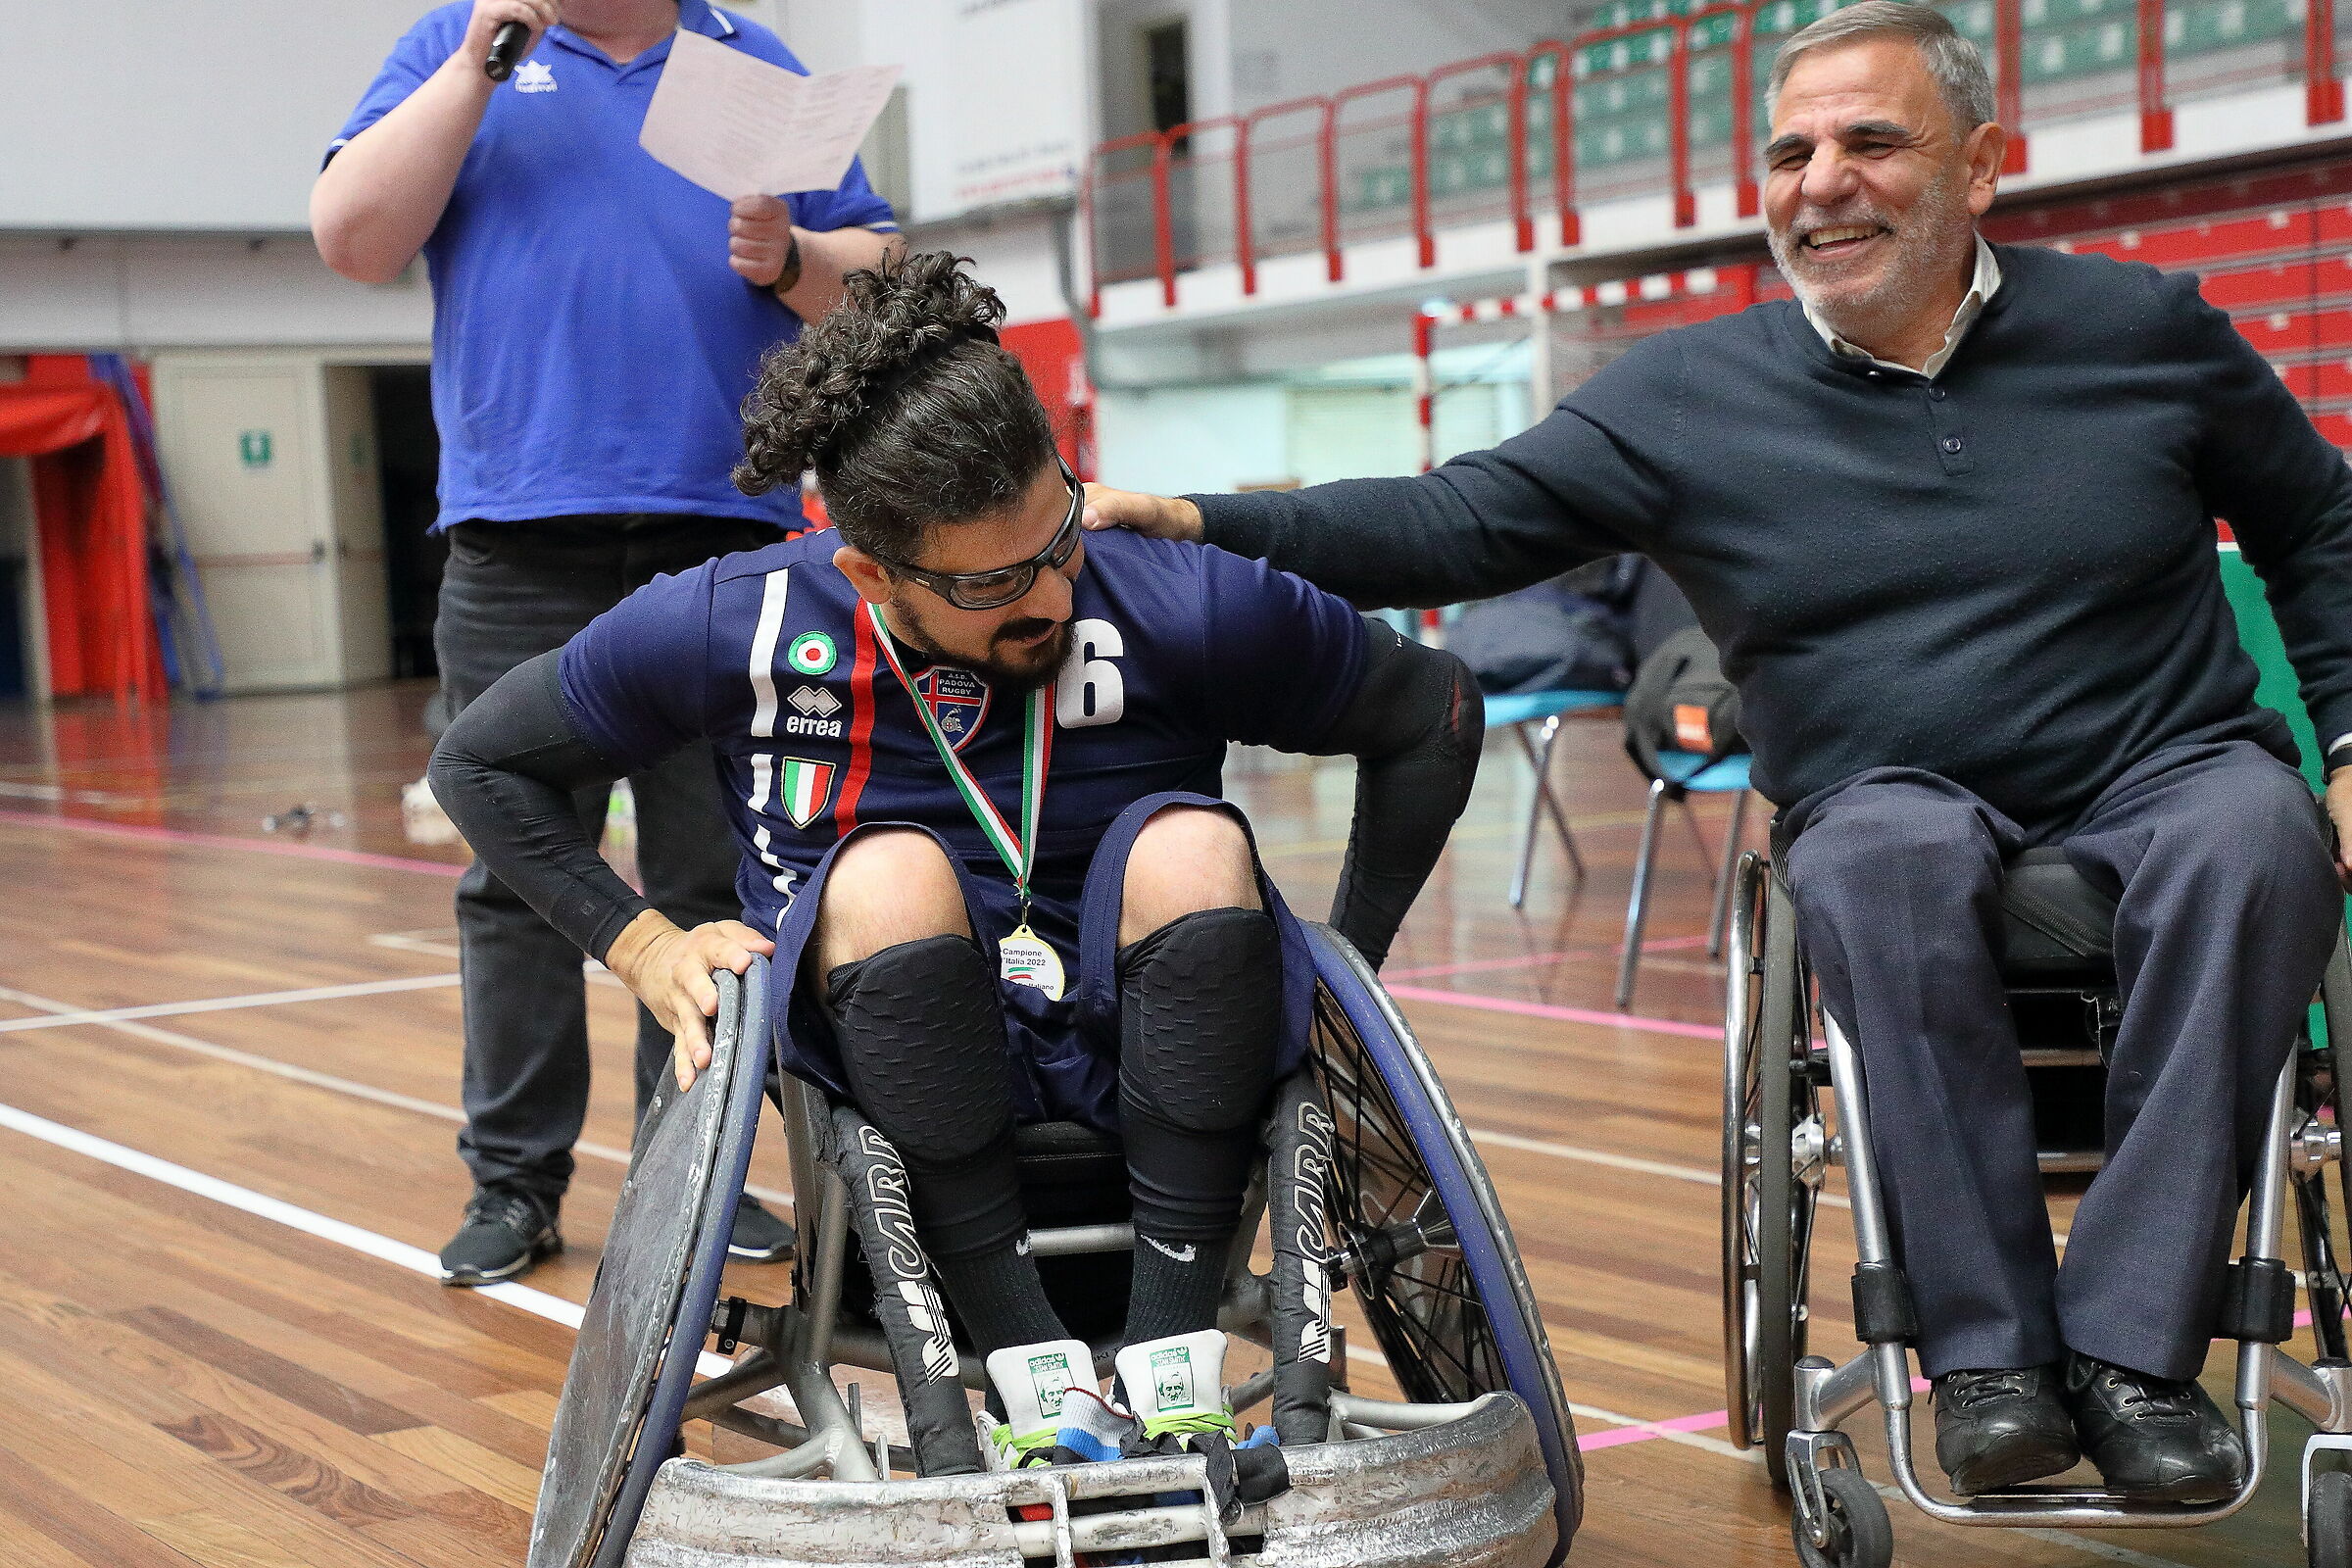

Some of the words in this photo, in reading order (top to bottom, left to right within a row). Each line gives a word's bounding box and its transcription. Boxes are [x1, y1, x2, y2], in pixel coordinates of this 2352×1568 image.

[1056, 618, 1124, 729] 6
[939, 679, 976, 688] PADOVA
[1003, 948, 1043, 956] Campione
[1030, 1355, 1056, 1367] adidas
[1152, 1350, 1178, 1361] adidas
